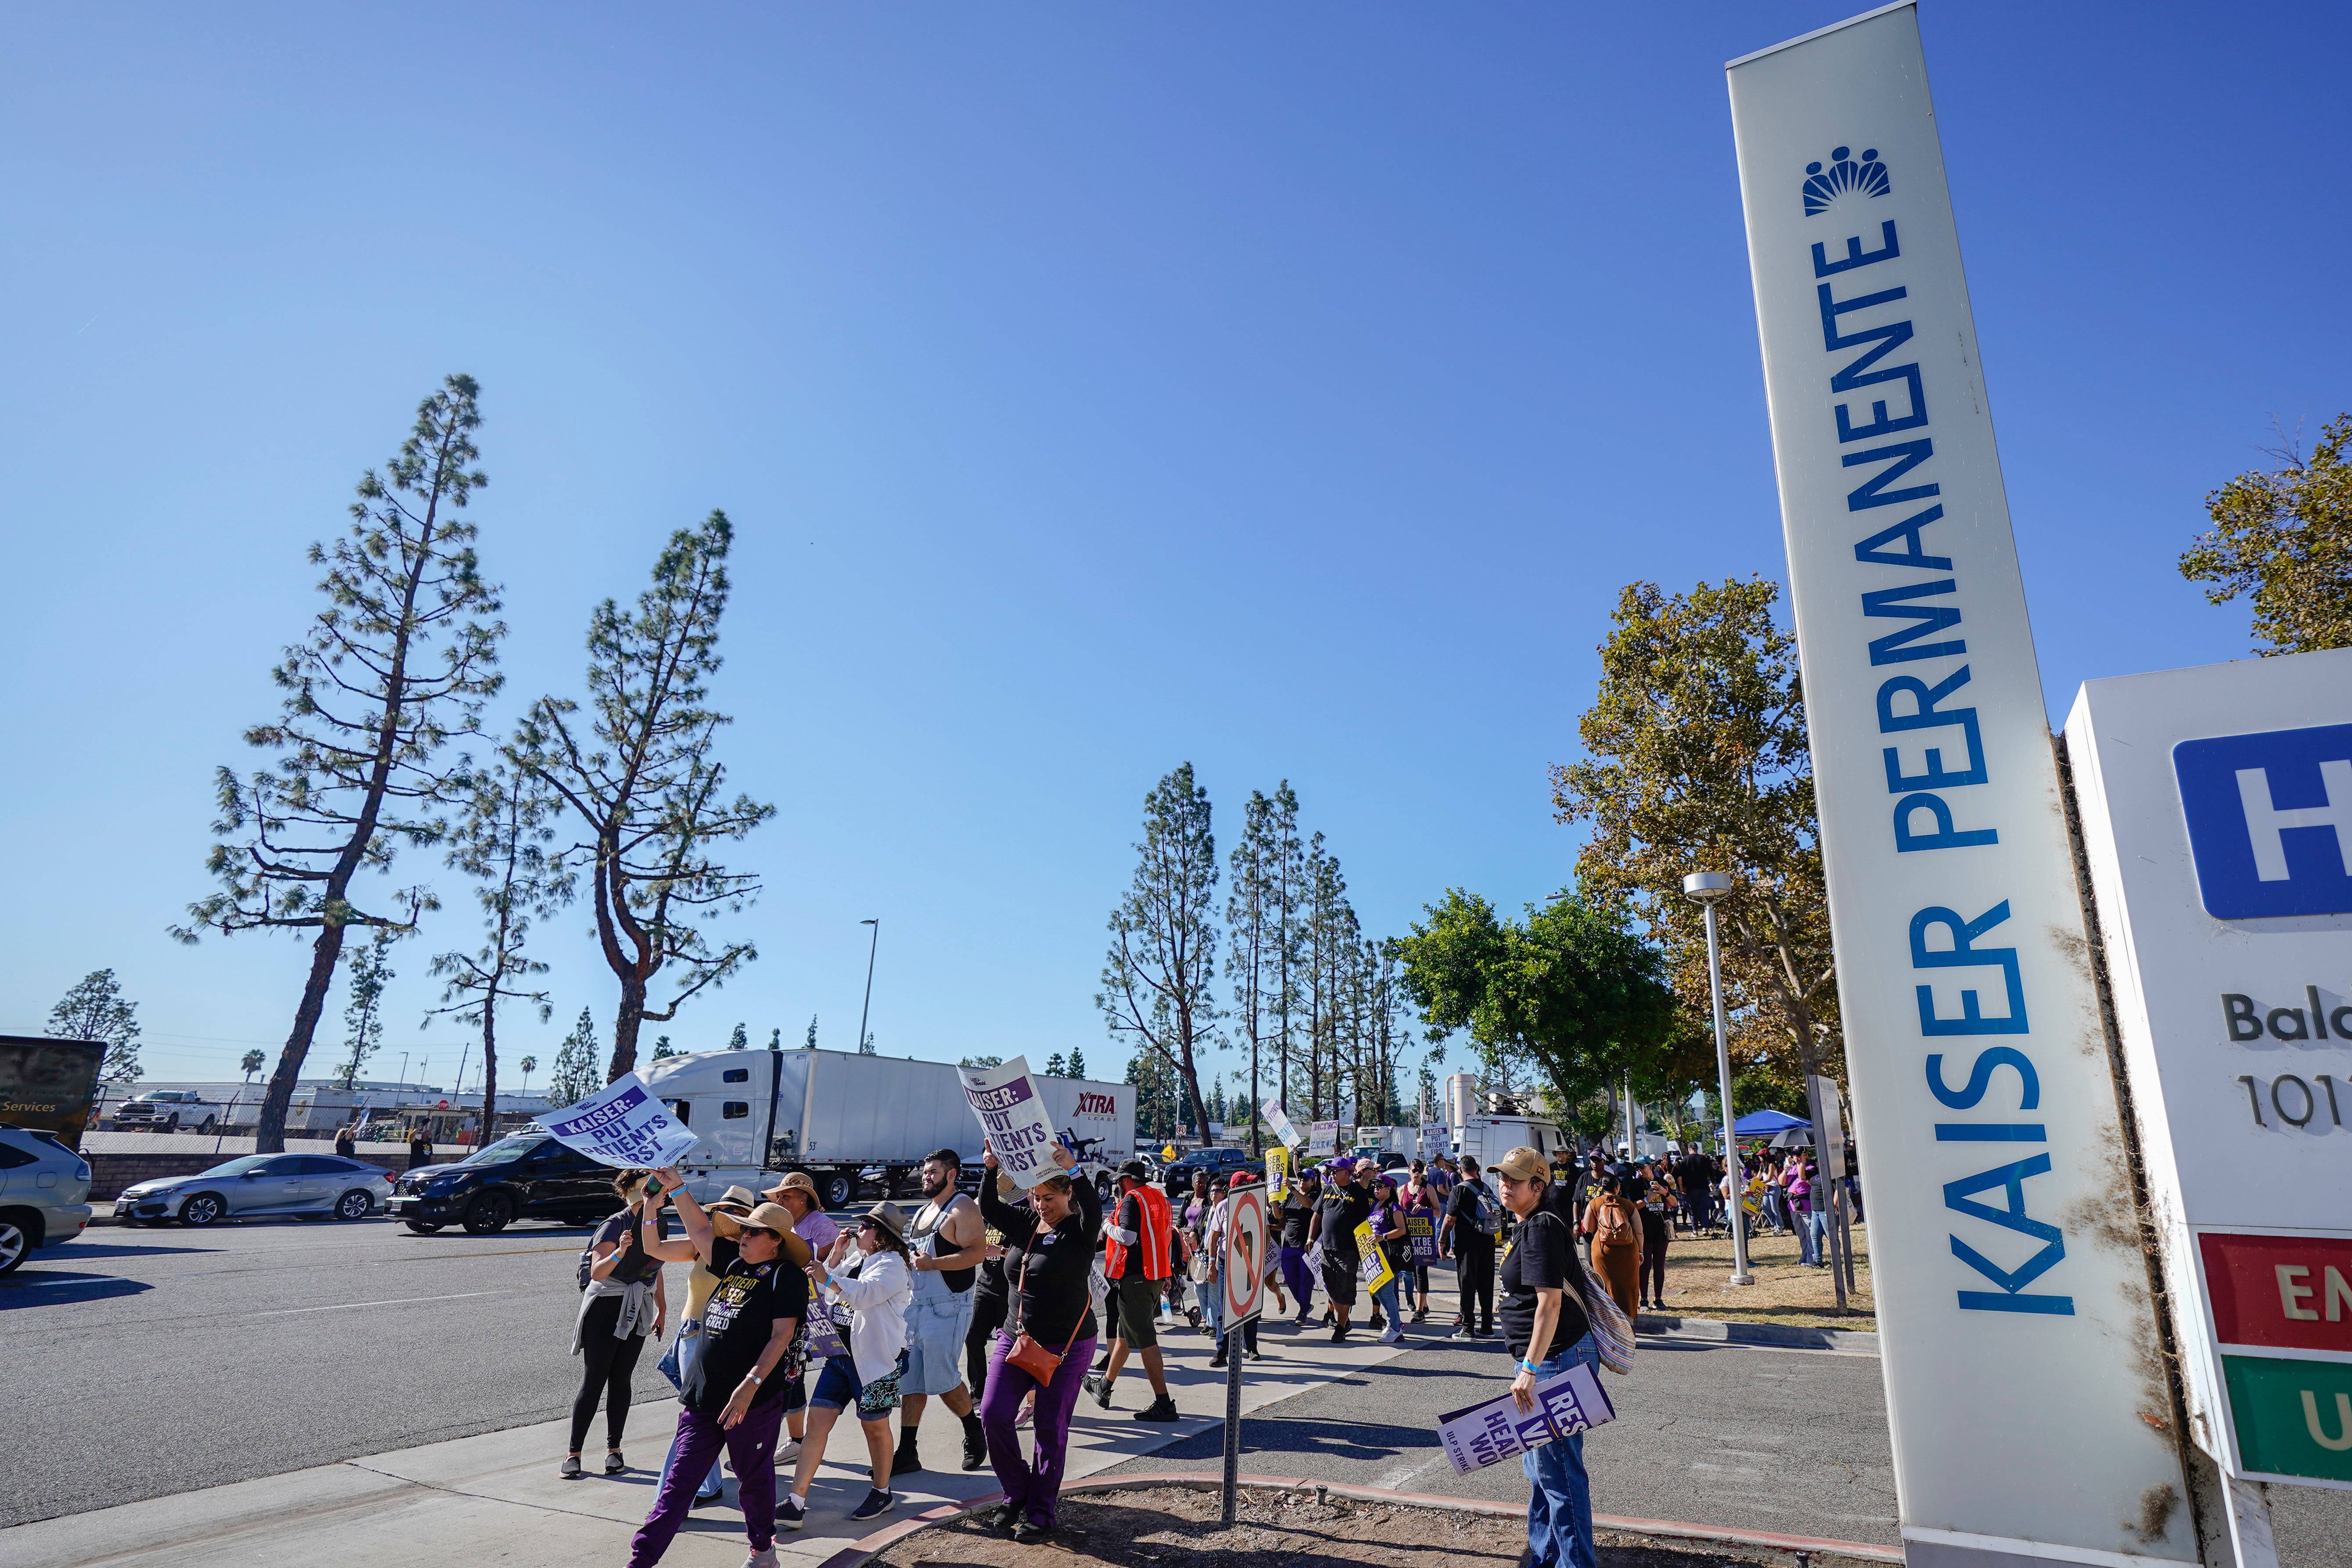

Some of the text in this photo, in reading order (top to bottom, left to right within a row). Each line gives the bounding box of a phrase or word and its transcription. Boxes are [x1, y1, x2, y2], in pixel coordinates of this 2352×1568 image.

[1811, 219, 2075, 1316] KAISER PERMANENTE
[2235, 759, 2352, 882] H
[2, 1101, 56, 1112] Services
[967, 1087, 1019, 1110] KAISER:
[1072, 1092, 1115, 1117] XTRA
[2237, 1074, 2352, 1126] 101
[564, 1099, 634, 1134] KAISER:
[591, 1116, 631, 1143] PUT
[982, 1110, 1012, 1132] PUT
[580, 1114, 668, 1156] PATIENTS
[983, 1122, 1047, 1152] ATIENTS
[1278, 1121, 1294, 1143] STAFF
[1426, 1141, 1449, 1149] PATIENTS
[609, 1136, 663, 1164] FIRST
[996, 1149, 1038, 1172] FIRST
[1412, 1246, 1432, 1255] NCED
[1423, 1237, 1431, 1246] BE
[723, 1274, 760, 1290] PATIENT
[705, 1314, 730, 1330] GREED
[811, 1302, 826, 1320] BE
[1547, 1391, 1588, 1437] RES
[2300, 1390, 2352, 1451] U
[1484, 1410, 1524, 1460] HEAL
[1446, 1431, 1471, 1472] ULP STRIKE
